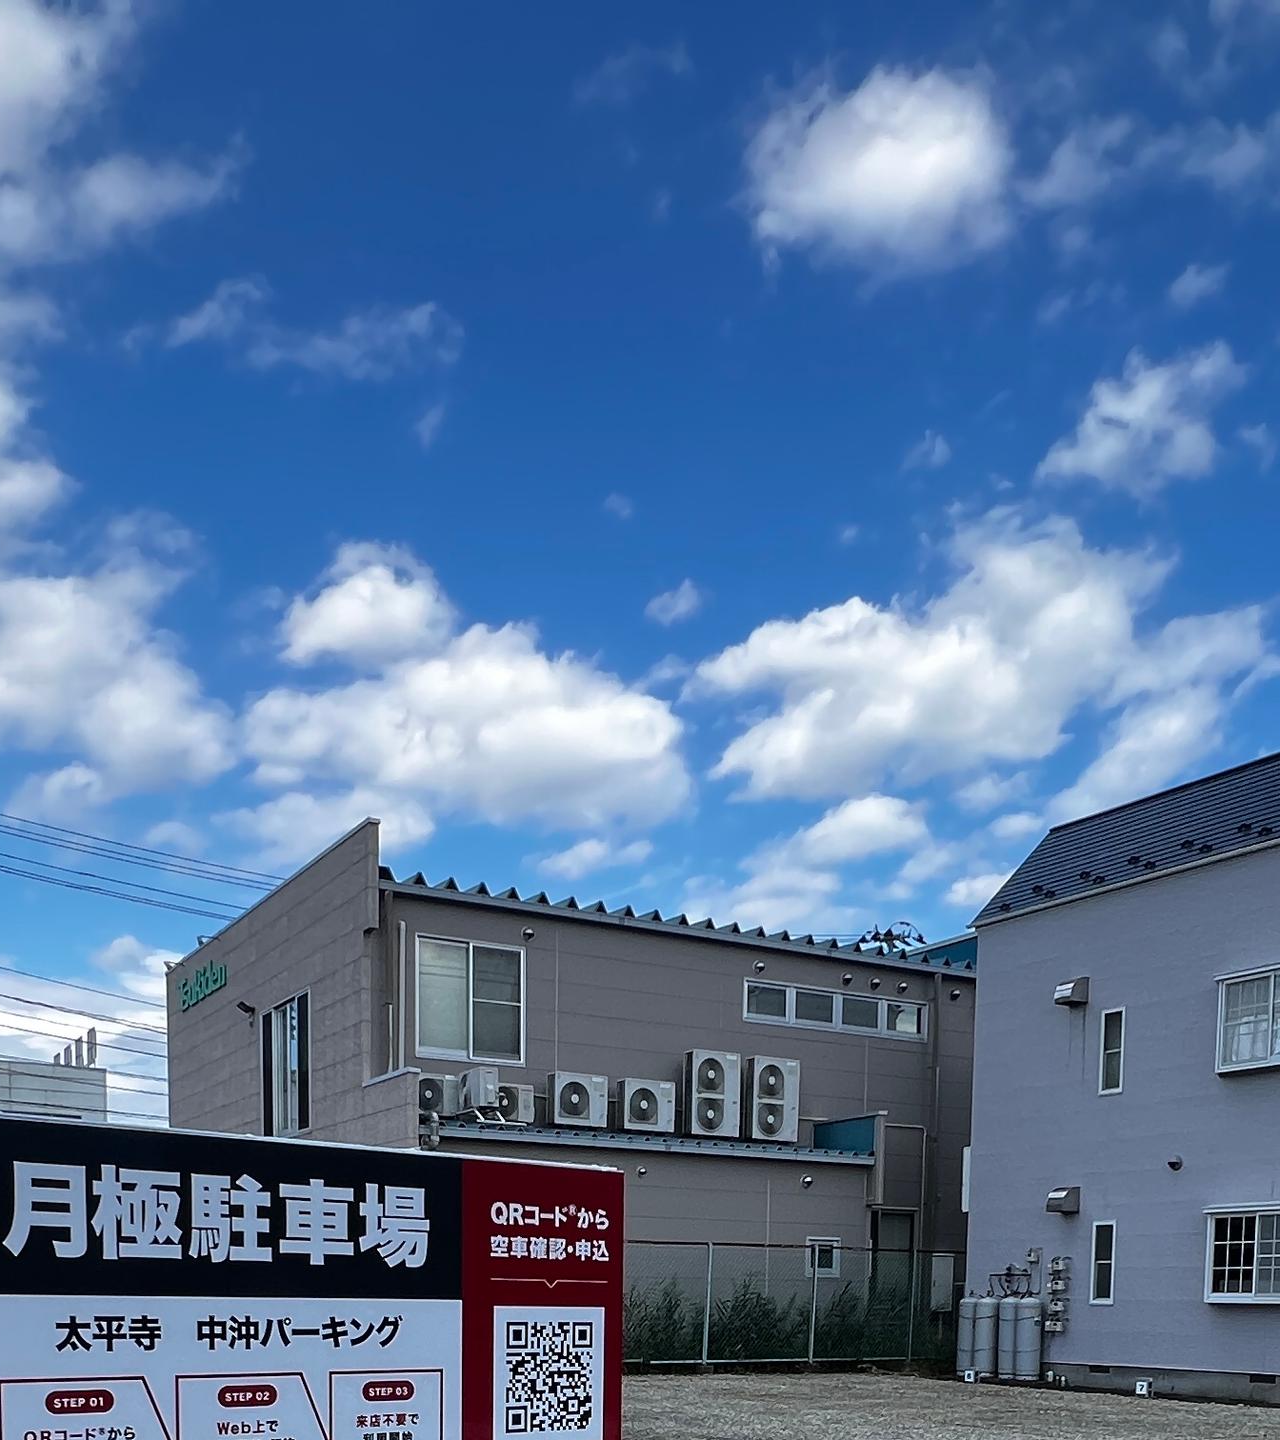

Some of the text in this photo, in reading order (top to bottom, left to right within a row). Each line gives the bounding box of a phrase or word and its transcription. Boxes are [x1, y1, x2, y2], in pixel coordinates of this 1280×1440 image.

[2, 1160, 430, 1269] 月極駐車場
[490, 1234, 610, 1262] 空車確認・申込
[55, 1314, 404, 1352] 太平寺 中沖パーキング
[224, 1391, 270, 1402] STEP 02
[368, 1387, 409, 1397] STEP 03
[53, 1396, 104, 1408] STEP 01
[217, 1419, 279, 1435] Web上で
[356, 1413, 419, 1429] 来店不要で
